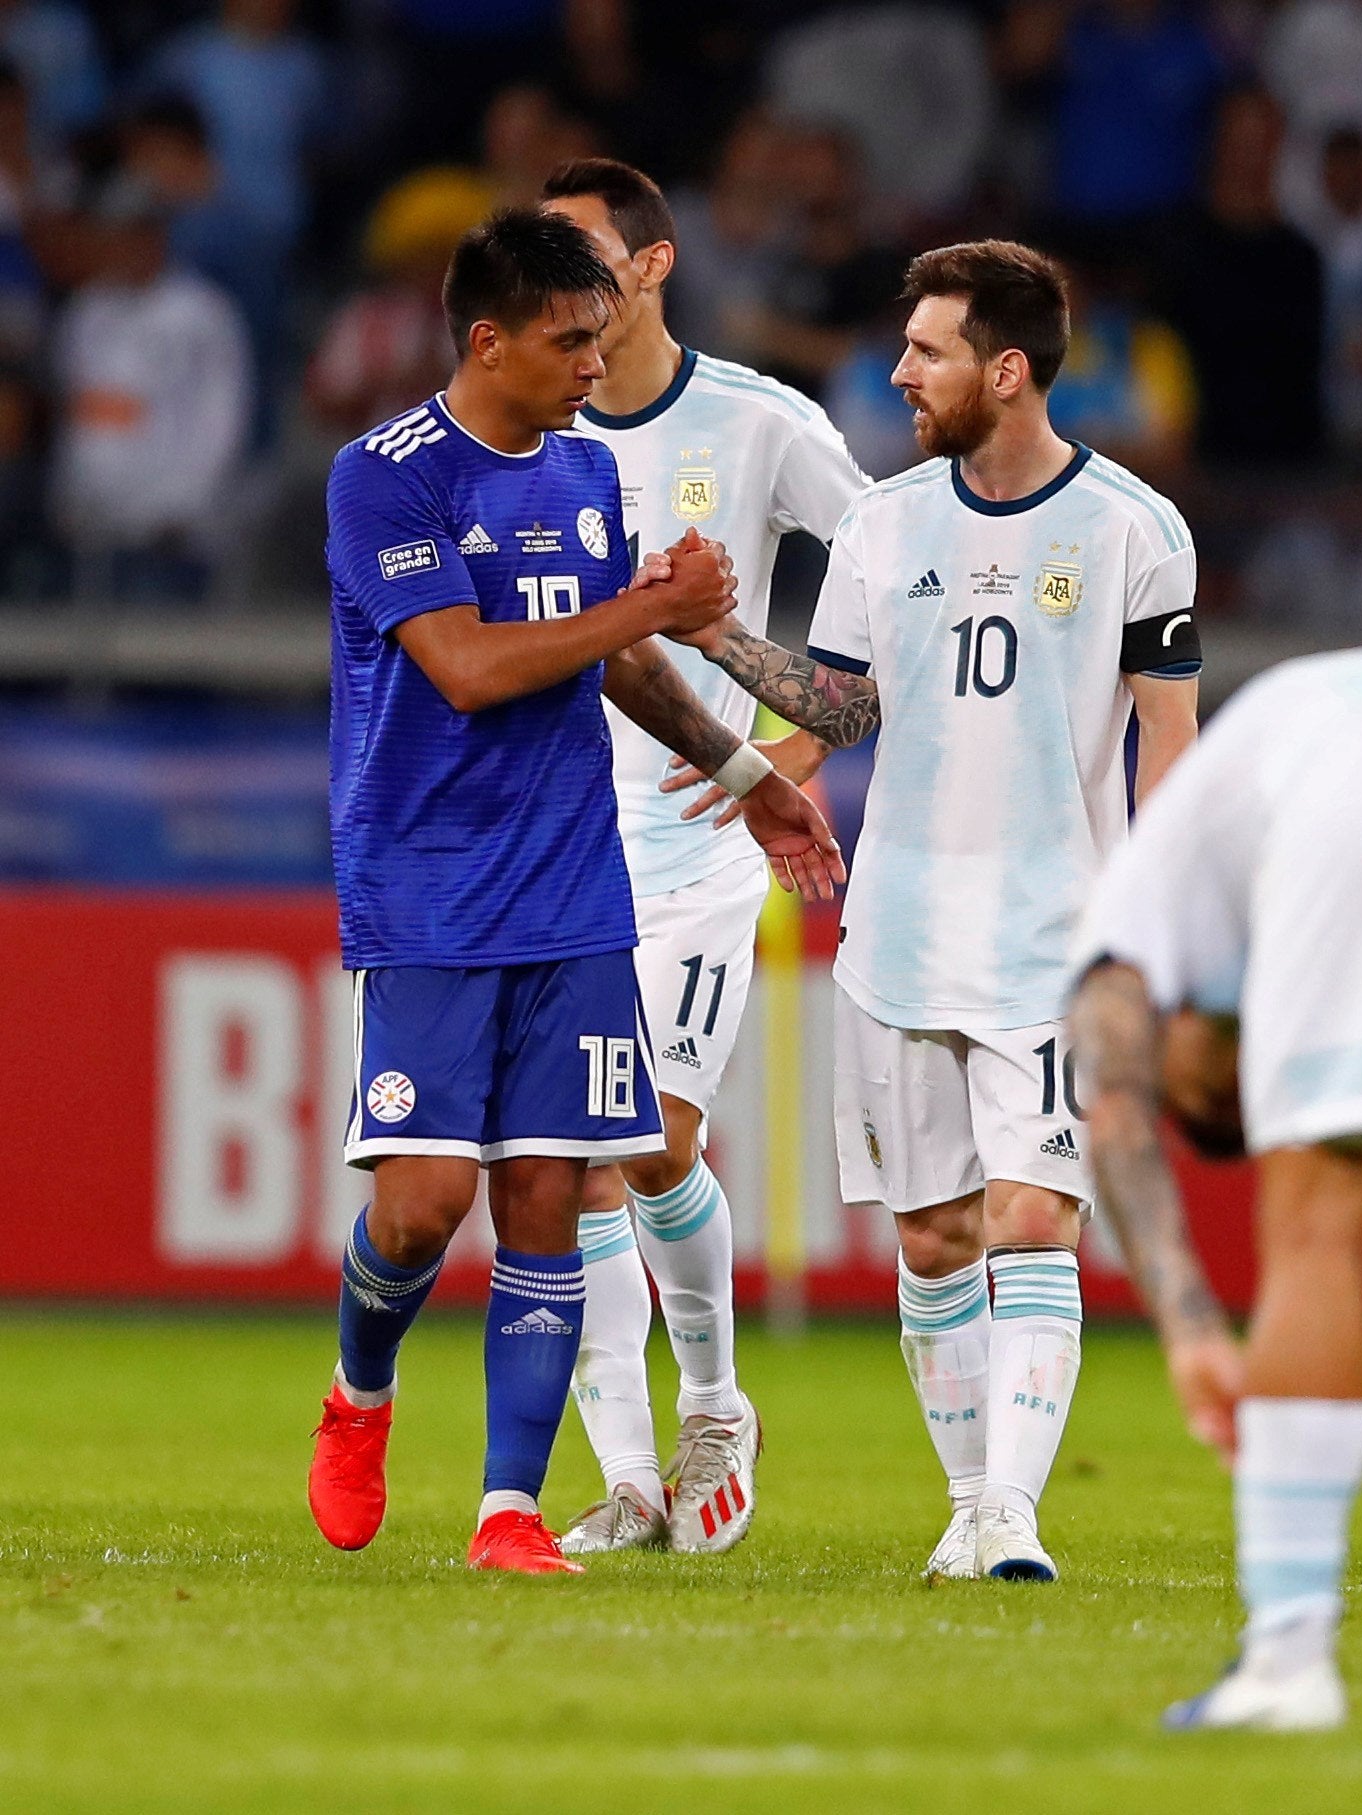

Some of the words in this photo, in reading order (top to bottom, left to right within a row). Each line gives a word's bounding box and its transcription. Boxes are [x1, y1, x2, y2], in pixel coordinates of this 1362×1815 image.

[682, 483, 708, 506] AFA
[383, 550, 413, 564] Cree
[414, 545, 432, 556] en
[385, 555, 431, 577] grande
[907, 587, 946, 599] adidas
[1043, 575, 1070, 602] AFA
[950, 615, 1018, 698] 10
[675, 953, 727, 1037] 11
[662, 1050, 702, 1069] adidas
[579, 1035, 638, 1118] 18
[1040, 1143, 1080, 1161] adidas
[501, 1321, 574, 1335] adidas
